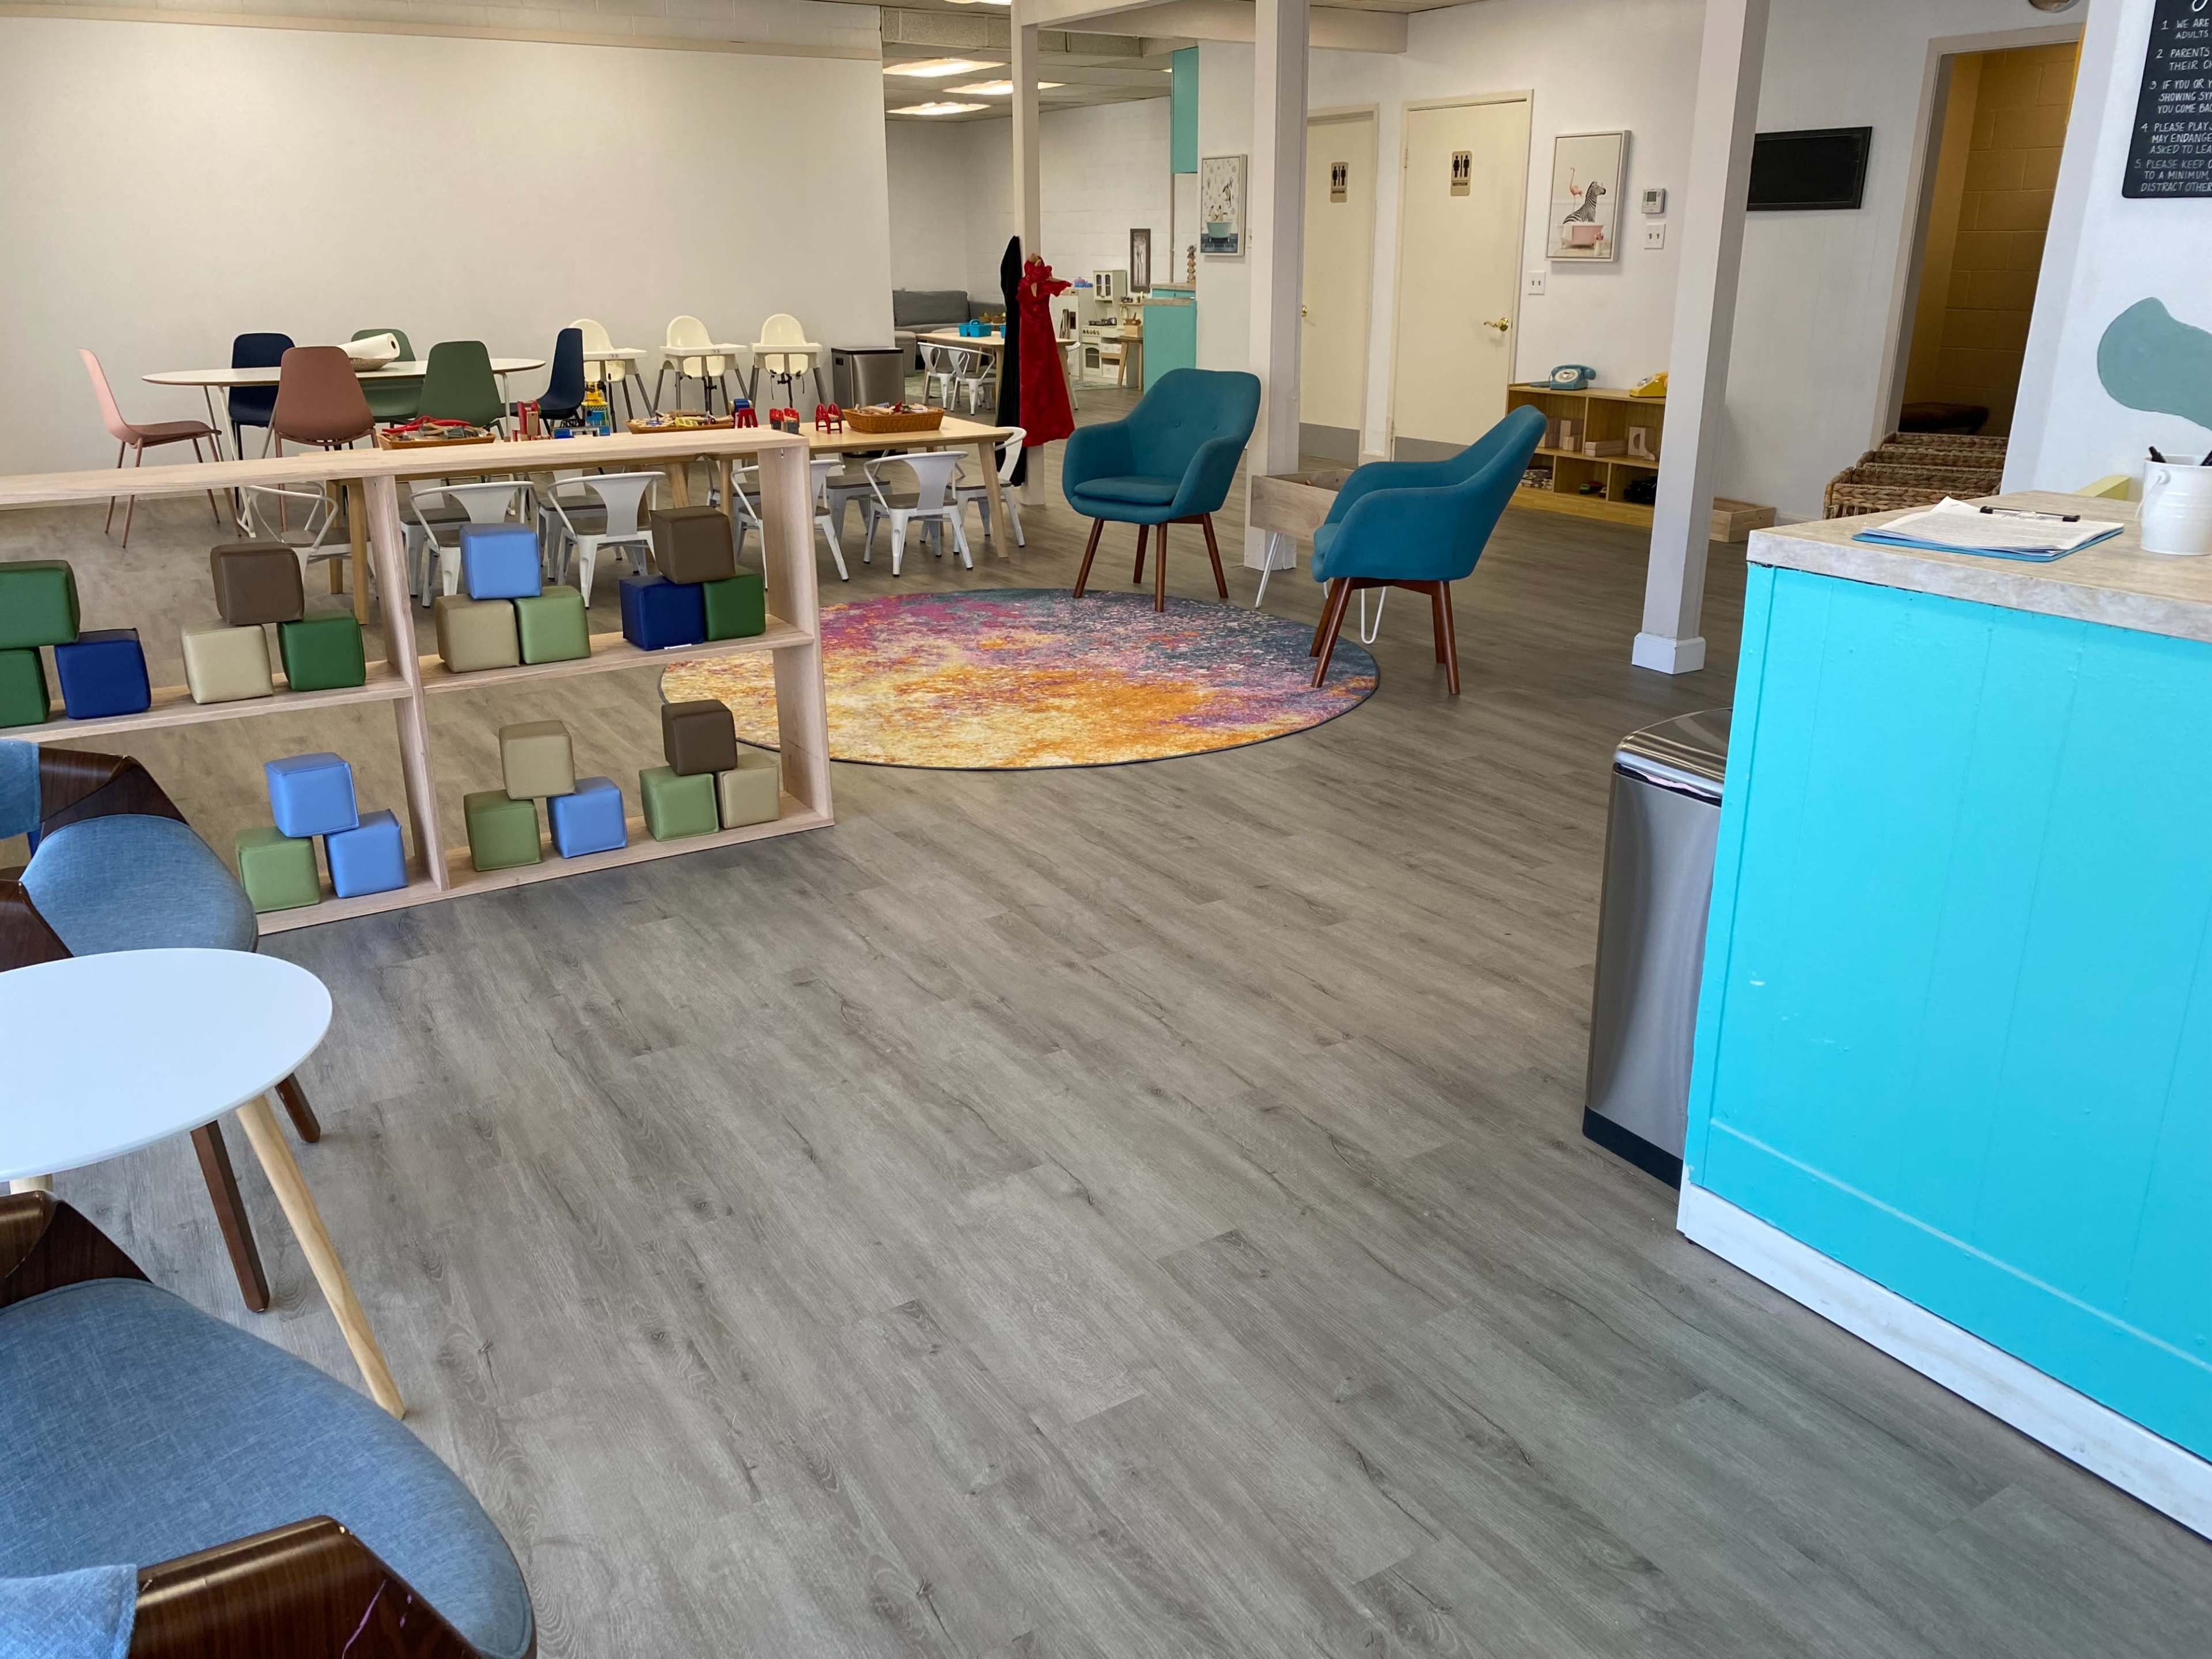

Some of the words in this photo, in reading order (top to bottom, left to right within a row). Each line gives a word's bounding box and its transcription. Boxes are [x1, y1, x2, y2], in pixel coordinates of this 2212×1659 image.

[2176, 18, 2189, 29] WE
[2192, 18, 2210, 28] ARE
[2175, 29, 2209, 39] ADULTS
[2170, 47, 2210, 58] PARENTS
[2169, 60, 2198, 71] THEIR
[2162, 79, 2172, 90] IF
[2175, 79, 2190, 89] YOU
[2193, 78, 2205, 89] OR
[2158, 91, 2196, 102] SHOWING
[2158, 104, 2174, 114] YOU
[2175, 103, 2196, 113] COME
[2154, 122, 2186, 132] PLEASE
[2188, 122, 2209, 131] PLAY
[2152, 134, 2169, 143] MAY
[2149, 144, 2180, 154] ASKED
[2181, 144, 2193, 154] TO
[2195, 144, 2212, 154] LEA
[2146, 159, 2178, 169] PLEASE
[2181, 159, 2205, 169] KEEP
[2145, 171, 2155, 180] TO
[2158, 171, 2164, 180] A
[2167, 170, 2210, 181] MINIMUM,
[2141, 181, 2184, 192] DISTRACT
